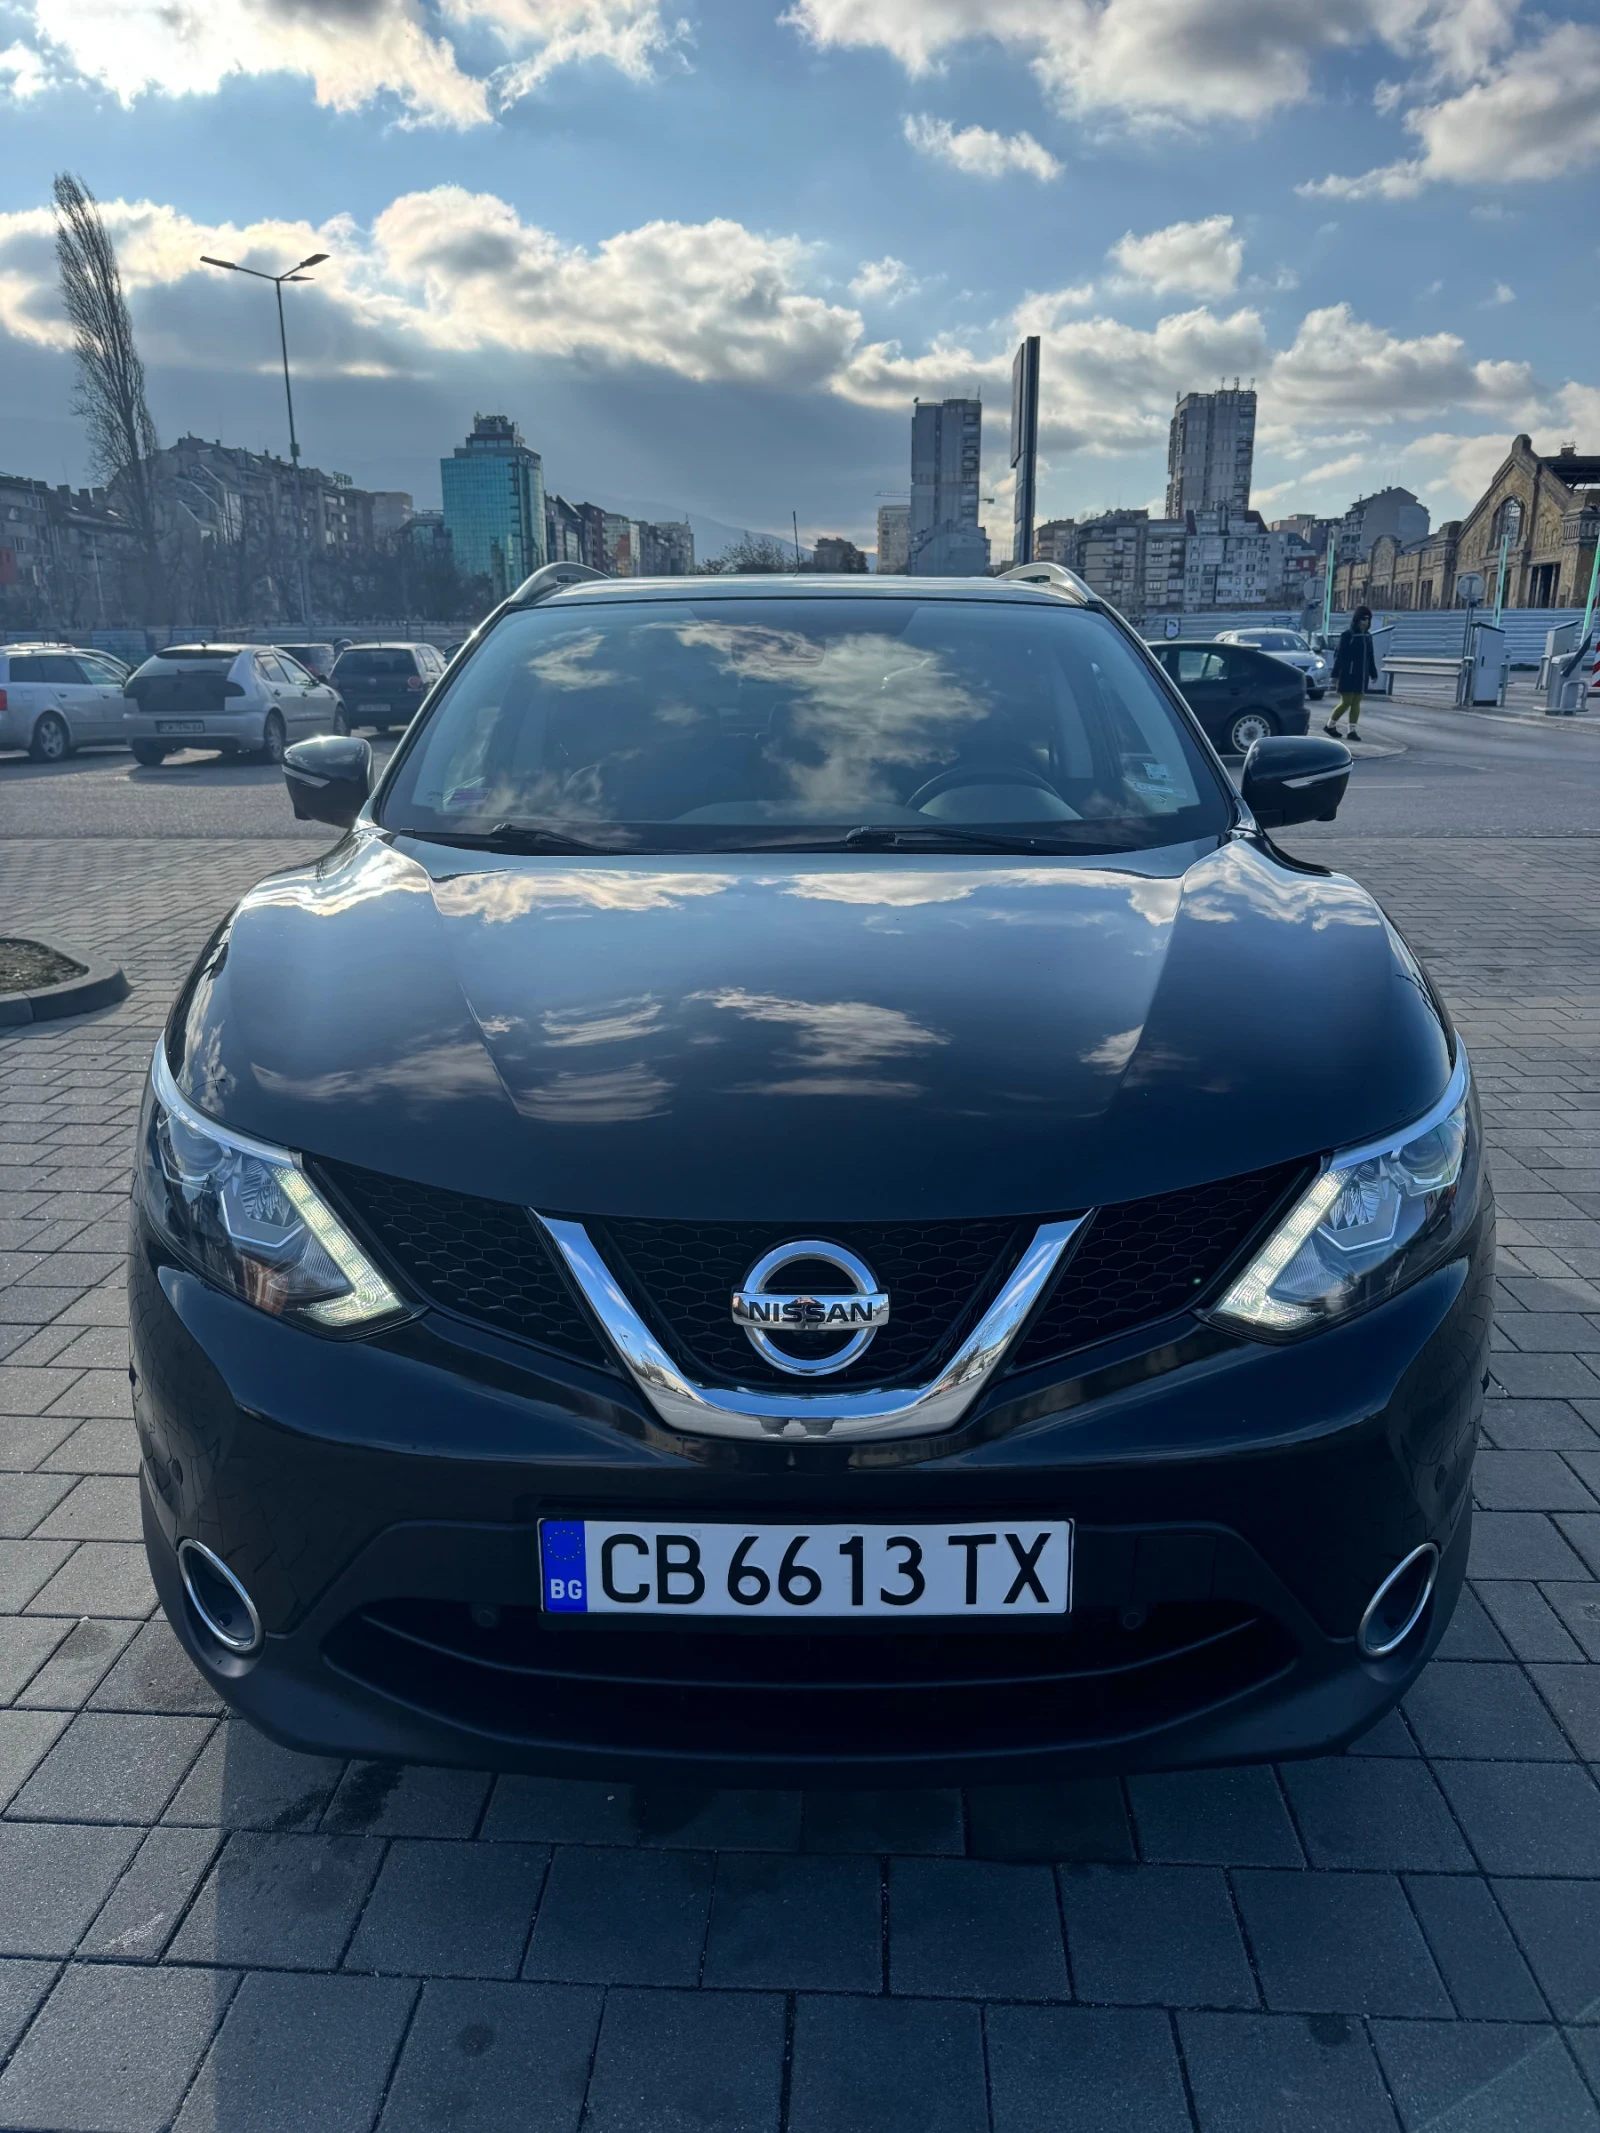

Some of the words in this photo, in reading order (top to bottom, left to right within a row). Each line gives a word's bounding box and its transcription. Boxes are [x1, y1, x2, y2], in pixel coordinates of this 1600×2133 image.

[748, 1301, 873, 1323] NISSAN
[601, 1533, 706, 1605] CB
[727, 1535, 926, 1607] 6613
[948, 1532, 1051, 1605] TX
[551, 1578, 582, 1599] BG
